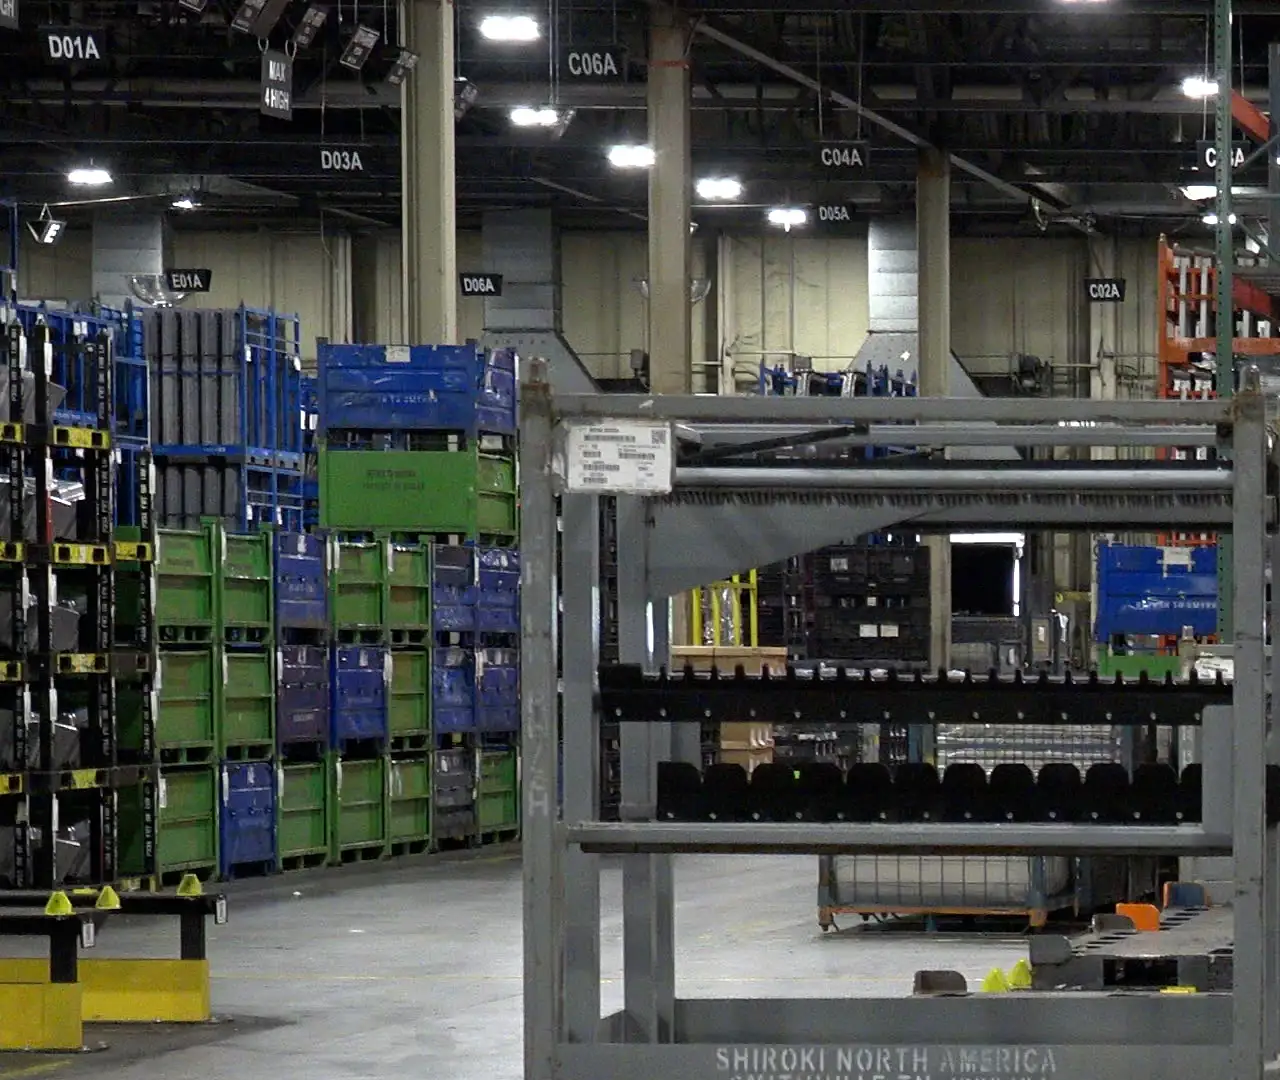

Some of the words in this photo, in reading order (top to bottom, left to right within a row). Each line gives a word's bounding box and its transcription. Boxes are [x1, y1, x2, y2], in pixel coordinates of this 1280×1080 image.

[48, 34, 101, 60] D01A
[268, 60, 286, 83] MAX
[568, 51, 617, 77] C06A
[264, 87, 271, 106] 4
[271, 88, 290, 111] HIGH
[321, 150, 363, 171] D03A
[820, 148, 863, 168] C04A
[1205, 147, 1245, 168] CA
[818, 205, 850, 221] D05A
[171, 272, 203, 289] E01A
[463, 277, 495, 293] D06A
[1089, 283, 1120, 299] C02A
[716, 1048, 824, 1072] SHIROKI
[836, 1048, 929, 1073] NORTH
[939, 1048, 1057, 1073] AMERICA
